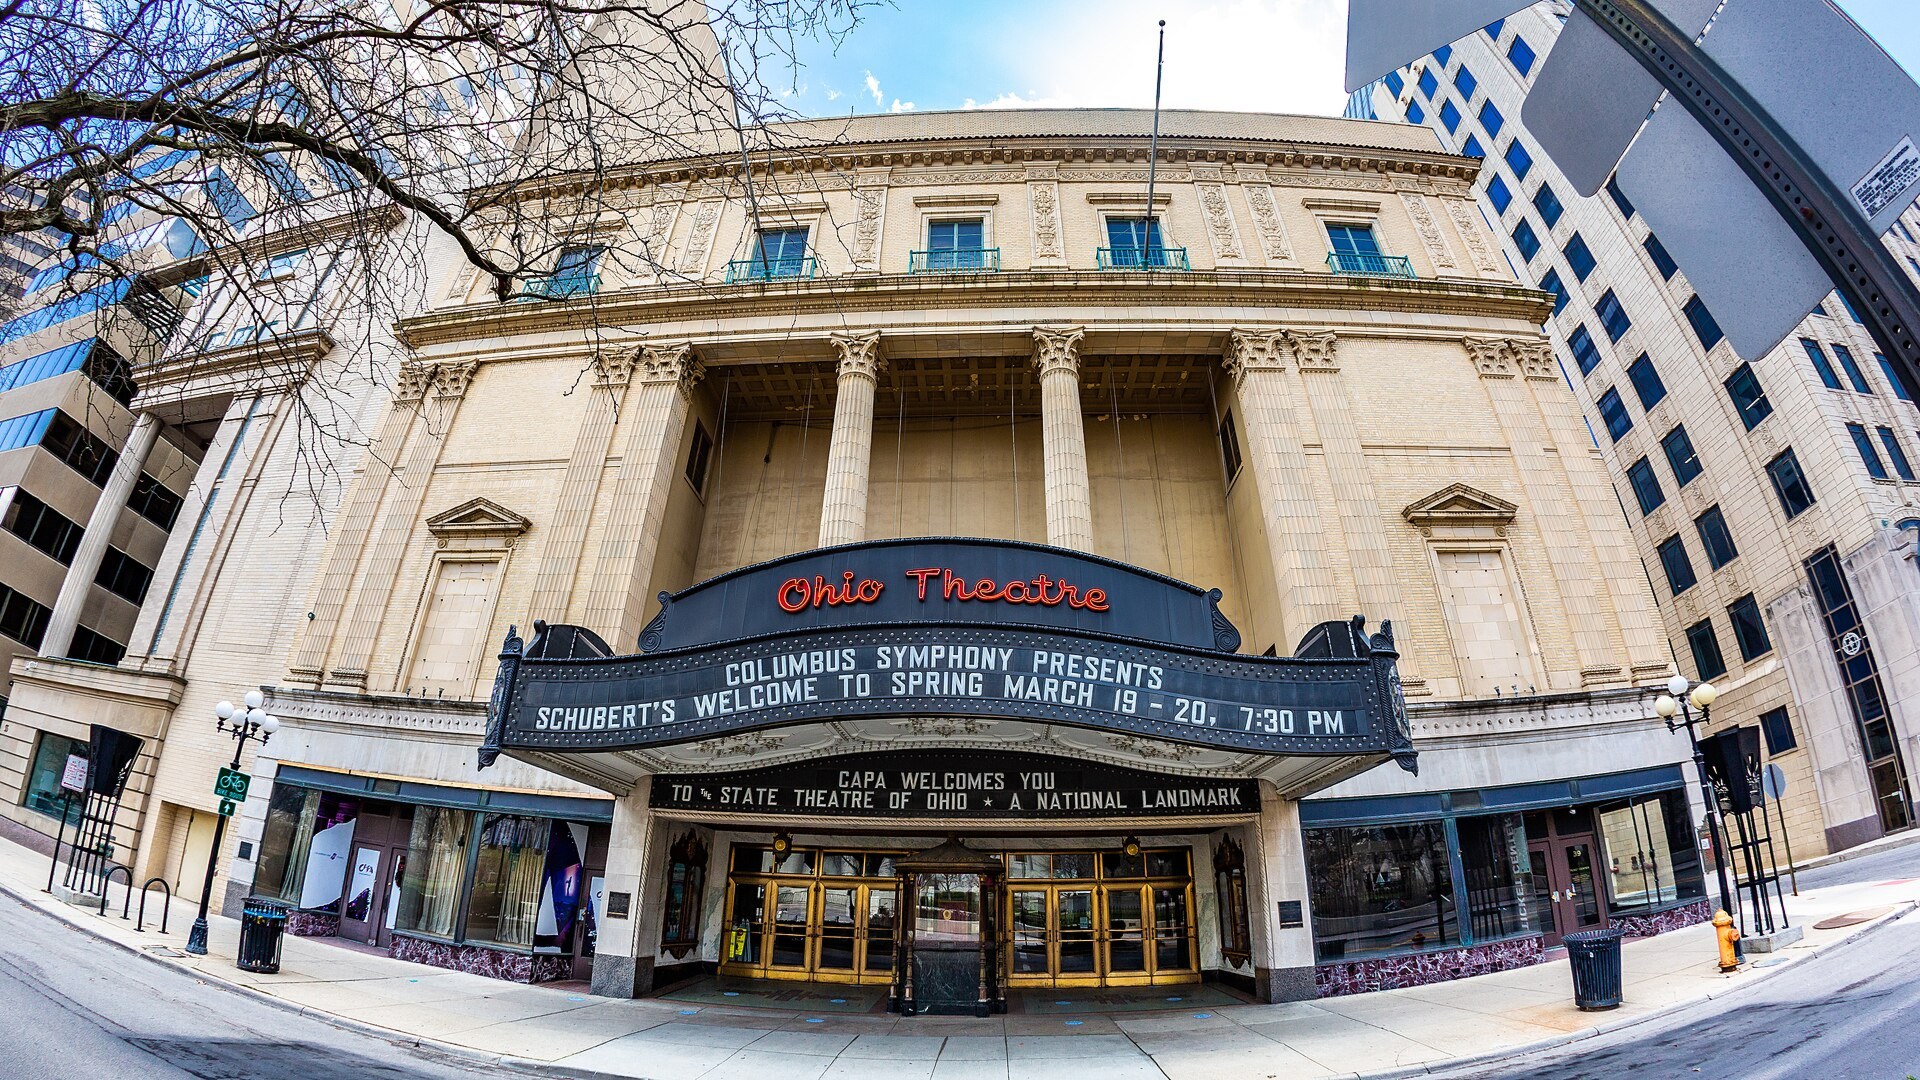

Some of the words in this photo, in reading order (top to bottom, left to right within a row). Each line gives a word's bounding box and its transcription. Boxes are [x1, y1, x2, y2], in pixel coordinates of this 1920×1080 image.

[777, 570, 885, 613] Ohio
[905, 568, 1110, 612] Theatre
[725, 648, 856, 687] COLUMBUS
[876, 645, 1014, 671] SYMPHONY
[1032, 650, 1163, 690] PRESENTS
[535, 699, 676, 731] SCHUBERT'S
[693, 677, 818, 718] WELCOME
[838, 673, 871, 698] TO
[891, 671, 983, 697] SPRING
[1003, 674, 1094, 708] MARCH
[1113, 688, 1138, 714] 19
[1174, 697, 1217, 728] 20,
[1239, 706, 1294, 734] 7:30
[1307, 710, 1345, 735] PM
[671, 784, 693, 802] TO
[720, 786, 779, 806] STATE
[793, 789, 875, 809] THEATRE
[889, 791, 912, 810] OF
[927, 792, 967, 810] OHIO
[1009, 792, 1022, 810] A
[1037, 792, 1127, 810] NATIONAL
[1142, 787, 1242, 809] LANDMARK
[838, 770, 887, 789] CAPA
[900, 772, 1005, 790] WELCOMES
[1019, 772, 1055, 790] YOU
[1572, 850, 1582, 858] 39
